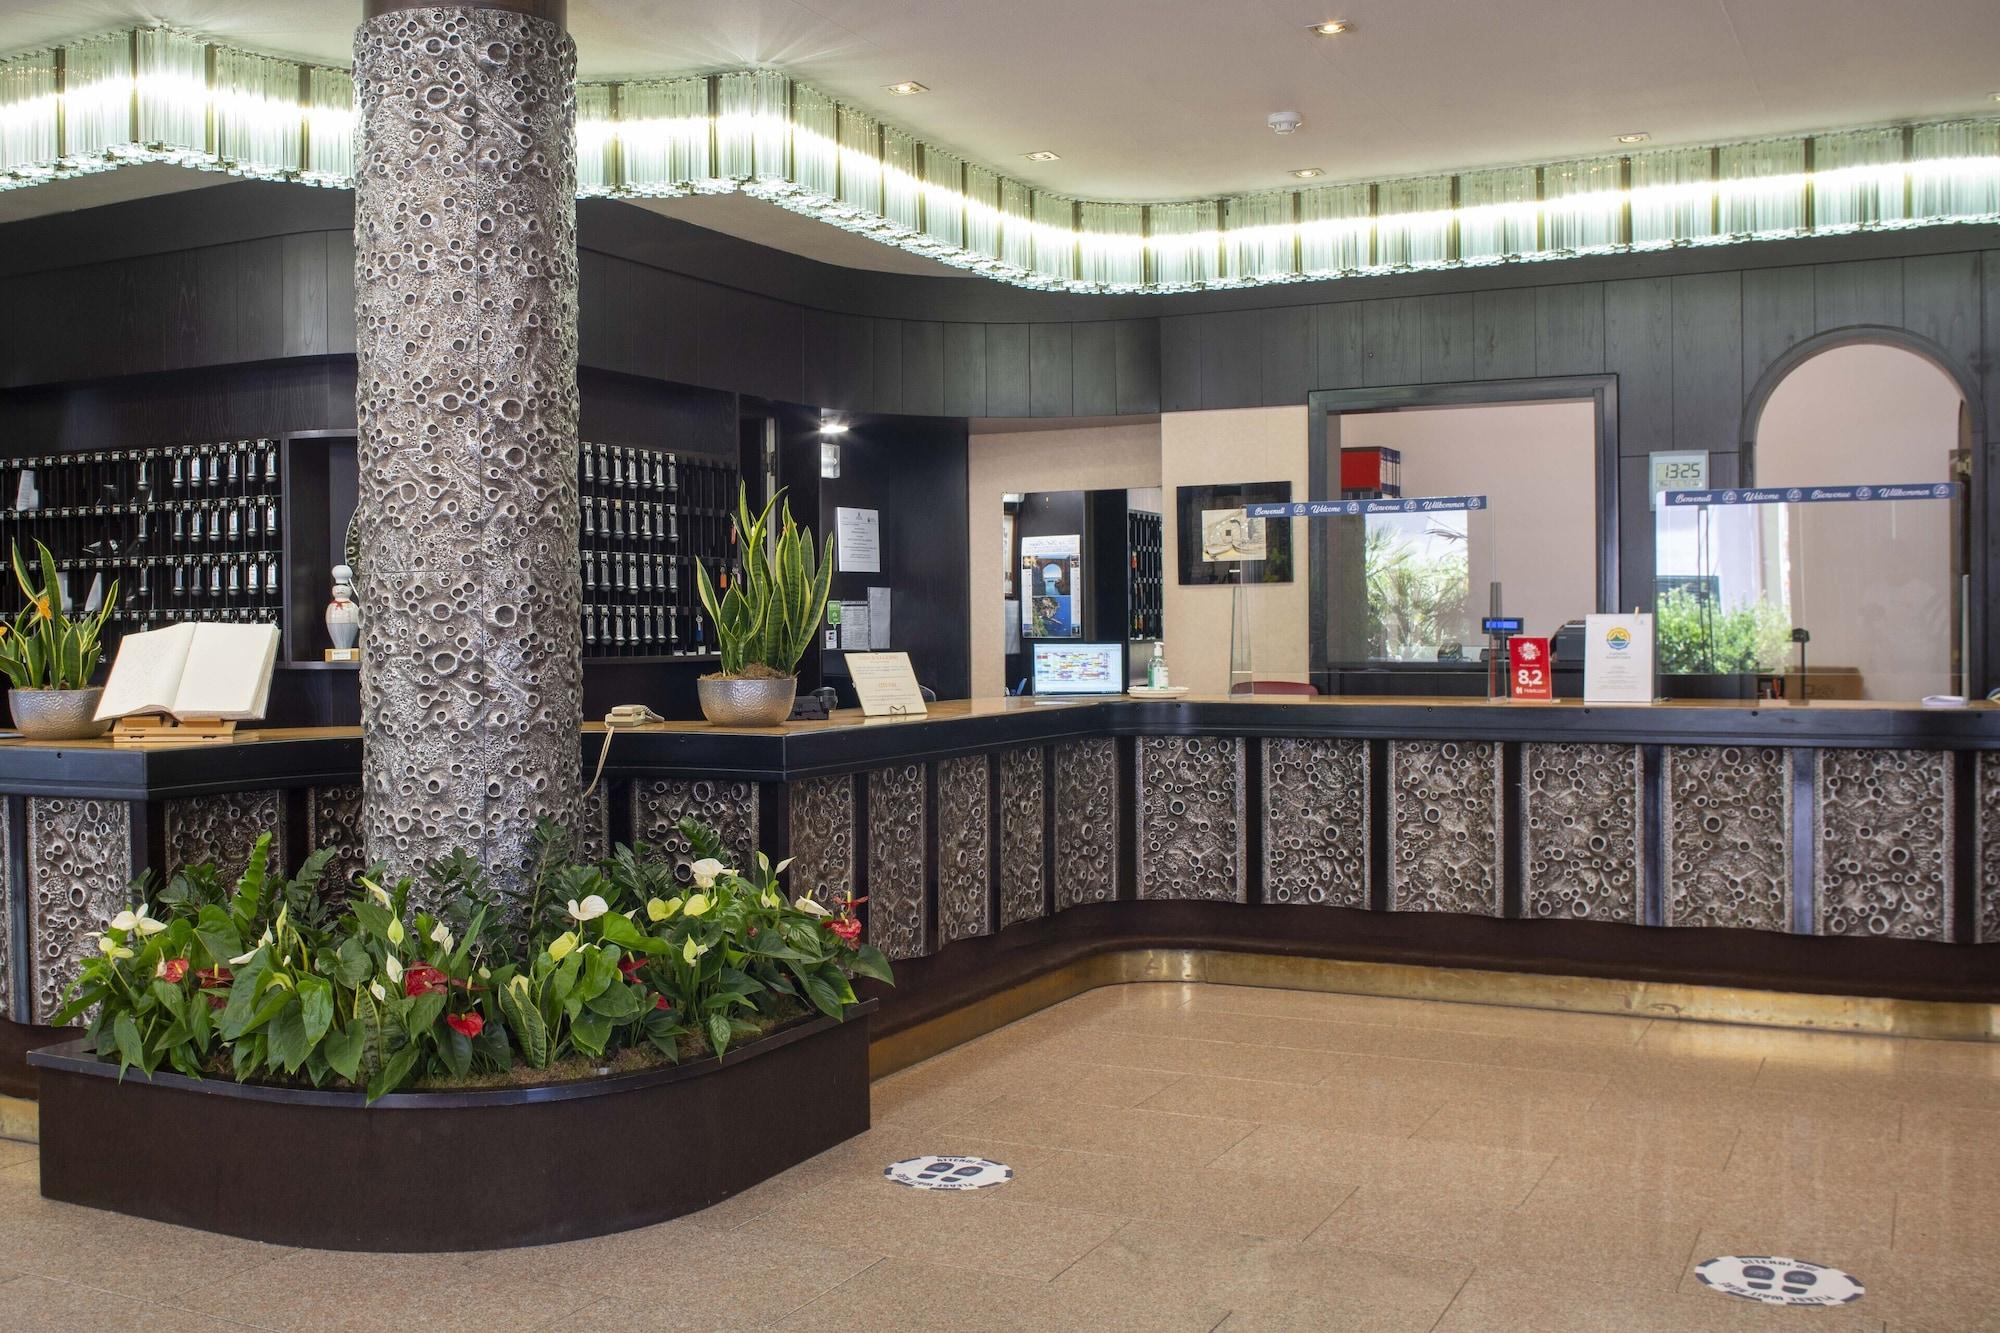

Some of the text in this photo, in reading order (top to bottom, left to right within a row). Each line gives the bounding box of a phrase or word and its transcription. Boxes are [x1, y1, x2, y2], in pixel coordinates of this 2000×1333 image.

[1665, 463, 1701, 479] 13:25
[1743, 491, 1780, 501] Welcome
[1811, 489, 1851, 499] Bienvenue
[1877, 487, 1930, 498] Willkommen
[1310, 504, 1341, 514] Welcome
[1366, 502, 1400, 512] Bienvenue
[1422, 500, 1465, 510] Willkommen
[1518, 669, 1543, 687] 8,2
[1750, 1291, 1785, 1301] WAIT
[1788, 1294, 1835, 1303] PLEASE
